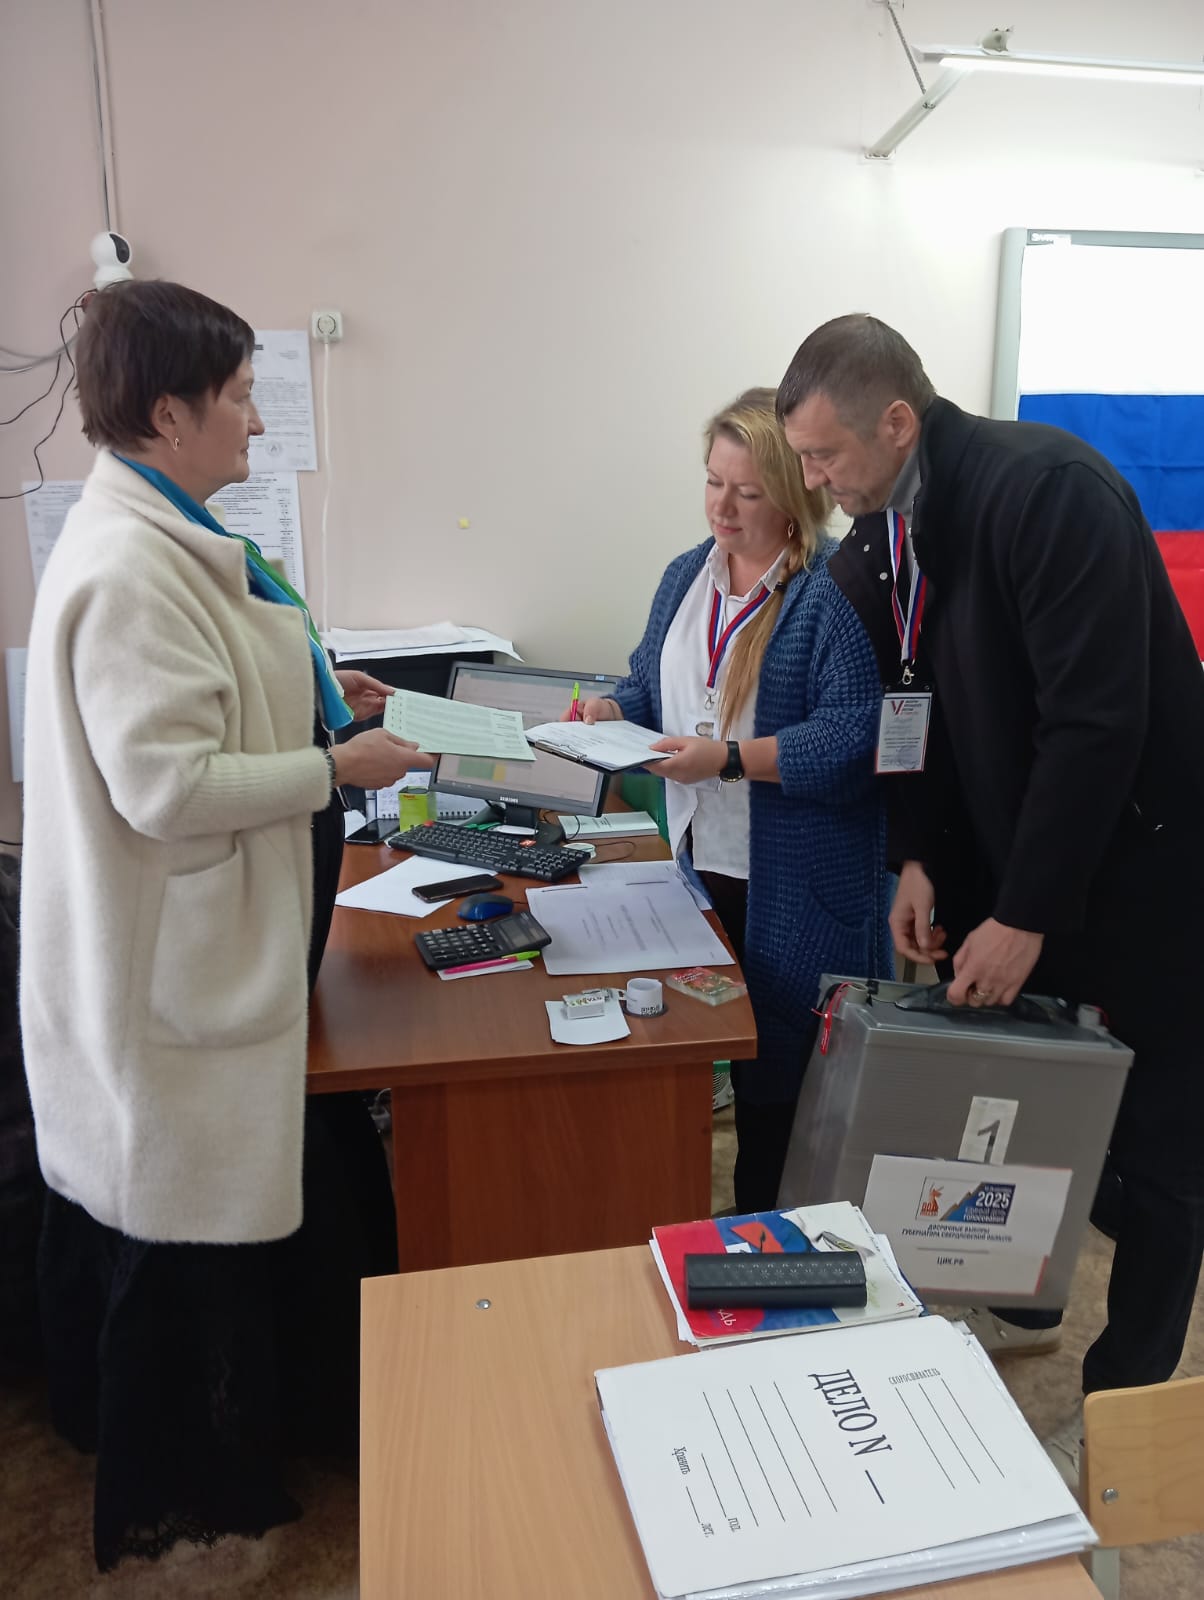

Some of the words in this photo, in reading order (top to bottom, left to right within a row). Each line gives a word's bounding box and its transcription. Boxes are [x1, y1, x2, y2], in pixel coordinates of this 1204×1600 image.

[977, 1120, 1000, 1163] 1
[976, 1191, 1010, 1209] 2025
[807, 1369, 877, 1431] ДЕЛО
[671, 1446, 691, 1475] Хранить
